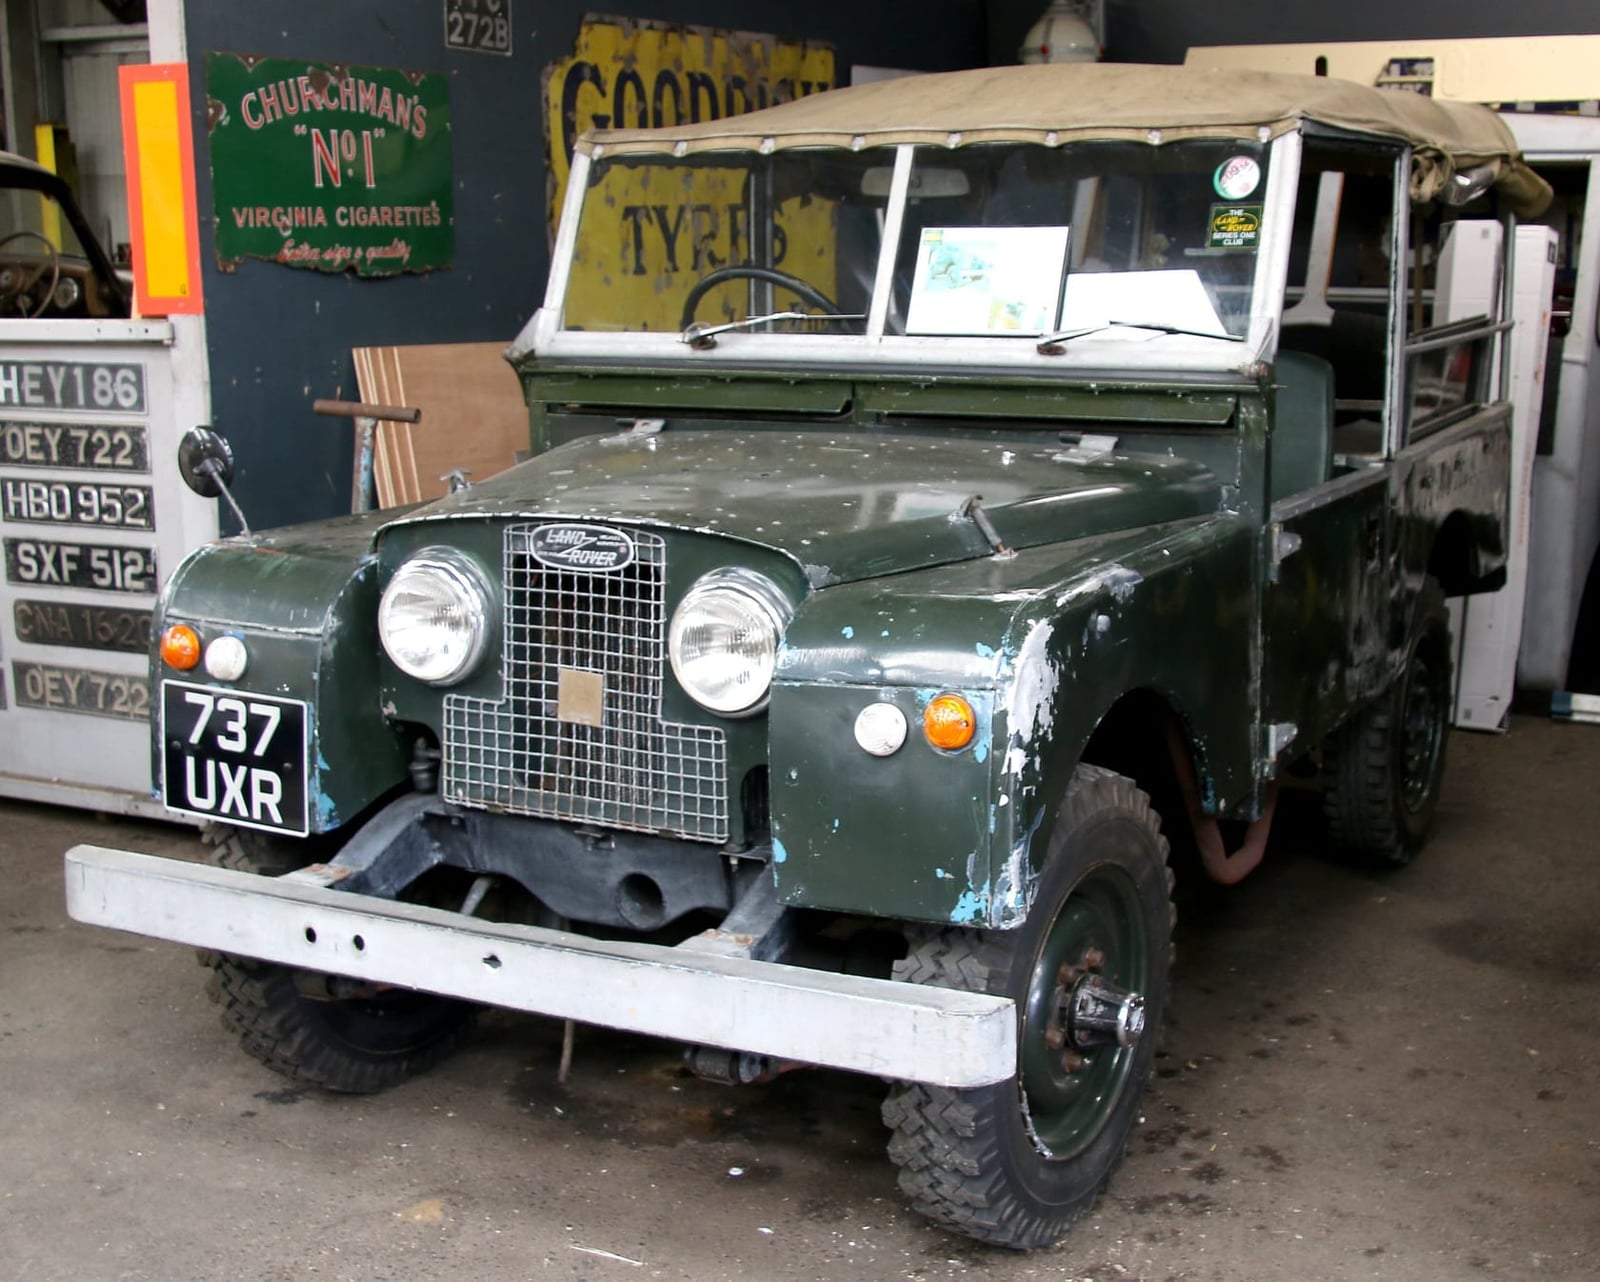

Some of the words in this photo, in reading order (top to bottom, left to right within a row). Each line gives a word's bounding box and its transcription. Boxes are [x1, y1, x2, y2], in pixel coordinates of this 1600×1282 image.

[448, 11, 508, 48] 272B
[241, 76, 427, 138] CHURCHMAN'S
[232, 206, 327, 228] VIRGINIA
[335, 206, 440, 226] CIGARETTES
[1214, 216, 1239, 224] LAND
[1227, 223, 1254, 231] ROVER
[5, 426, 62, 462] OEY
[70, 429, 133, 465] 722
[78, 486, 146, 526] 952
[546, 529, 587, 544] LAND
[17, 542, 80, 584] SXF
[90, 546, 145, 589] 512
[568, 549, 618, 566] ROVER
[16, 602, 73, 641] CNA
[25, 667, 81, 705] OEY
[89, 675, 149, 715] 722
[185, 691, 281, 757] 737
[186, 755, 283, 824] UXR
